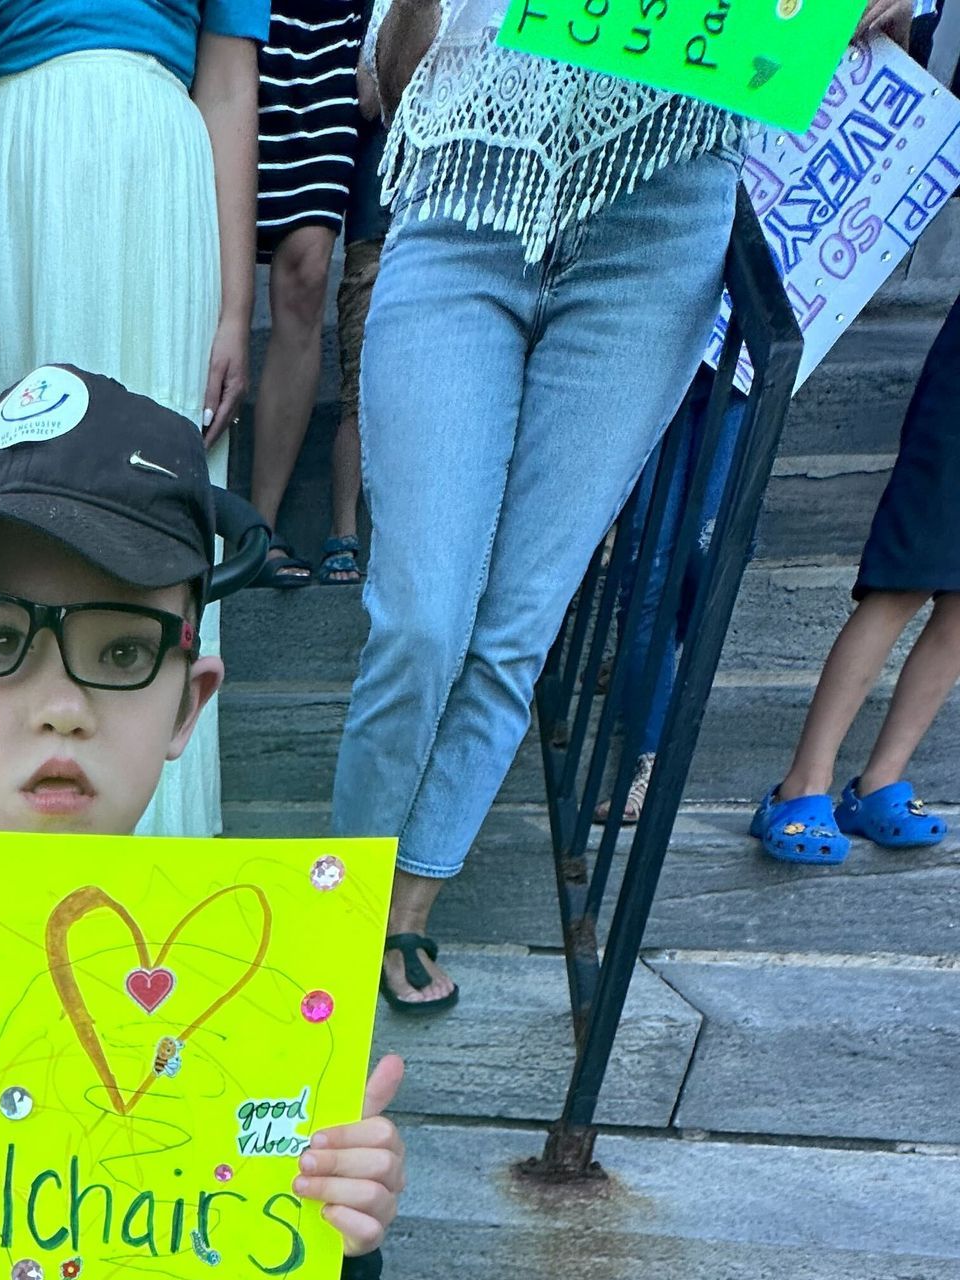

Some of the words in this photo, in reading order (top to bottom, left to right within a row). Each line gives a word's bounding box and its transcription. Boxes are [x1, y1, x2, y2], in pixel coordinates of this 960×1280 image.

[819, 196, 883, 280] SO
[14, 421, 61, 432] INCLUSIVE
[238, 1088, 307, 1131] good
[238, 1121, 309, 1154] vibes
